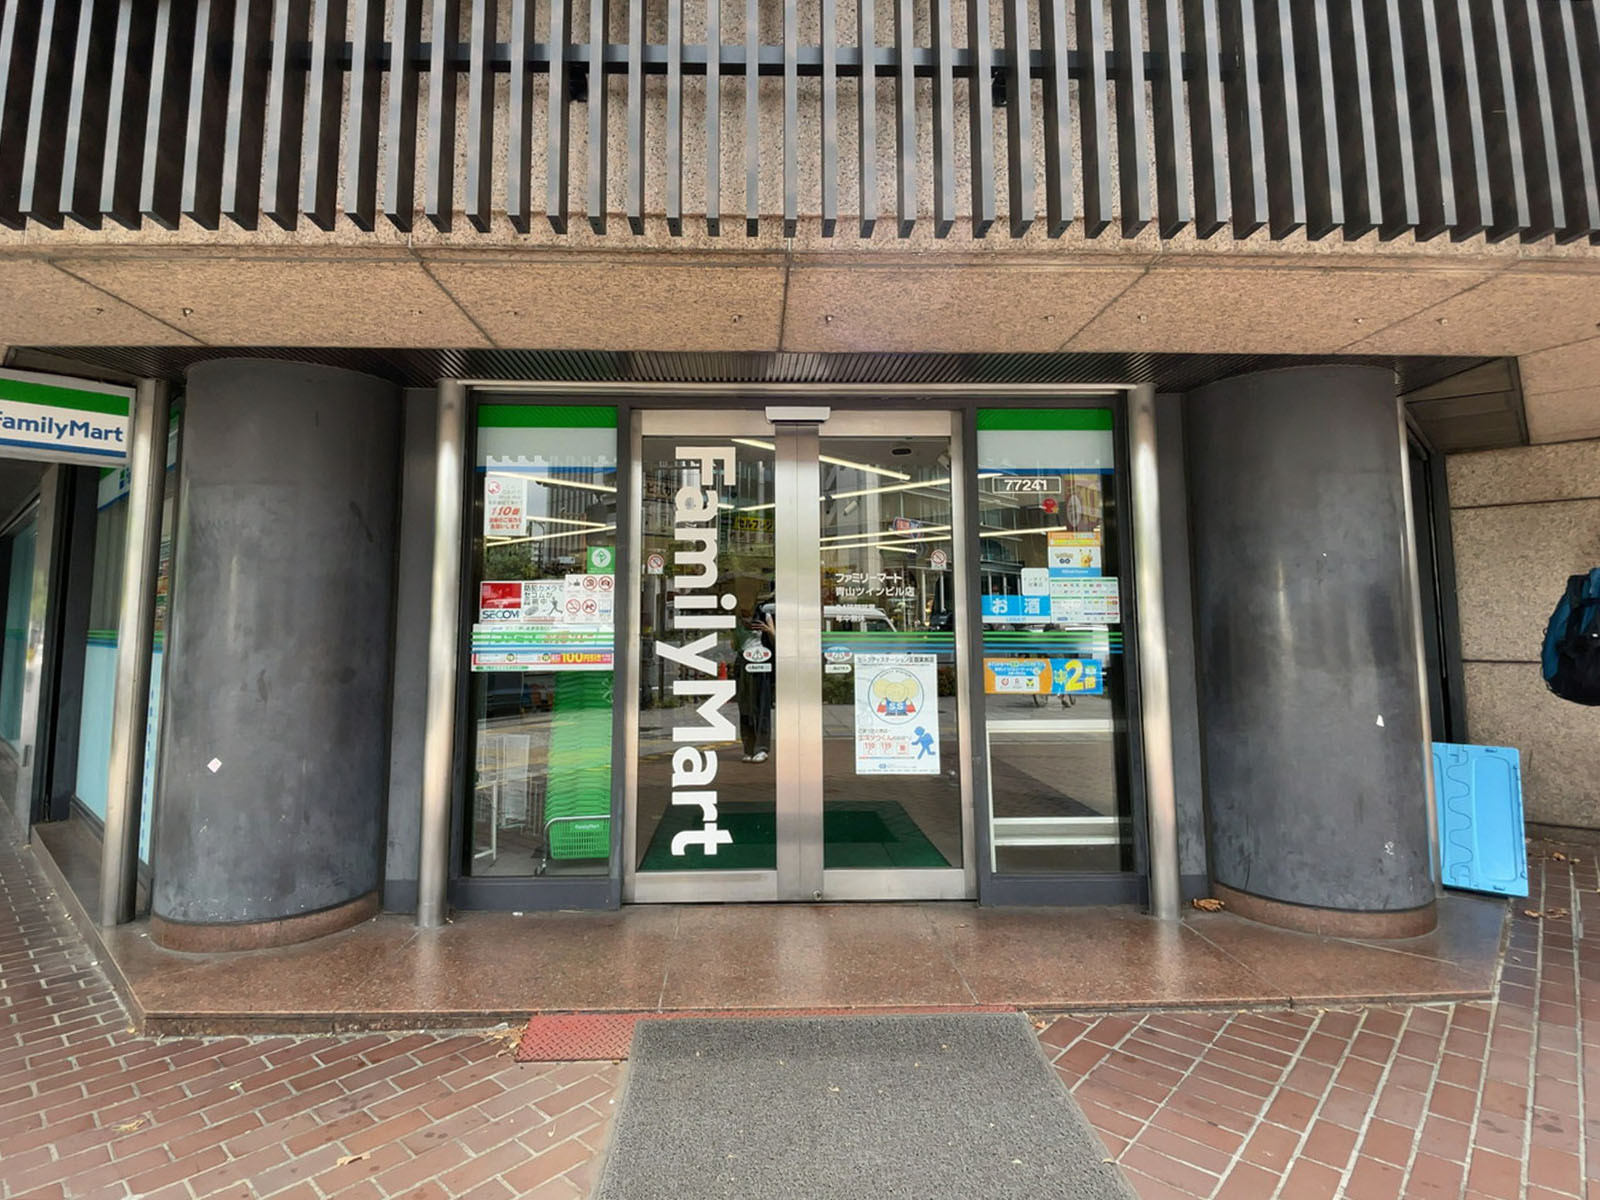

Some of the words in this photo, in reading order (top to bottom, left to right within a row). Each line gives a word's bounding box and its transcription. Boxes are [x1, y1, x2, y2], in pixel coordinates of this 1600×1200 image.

[1004, 479, 1048, 491] 77241
[835, 572, 903, 583] ファミリーマート
[835, 586, 915, 597] 青山ツインビル店
[482, 610, 520, 619] SECOM
[655, 446, 737, 856] FamilyMart
